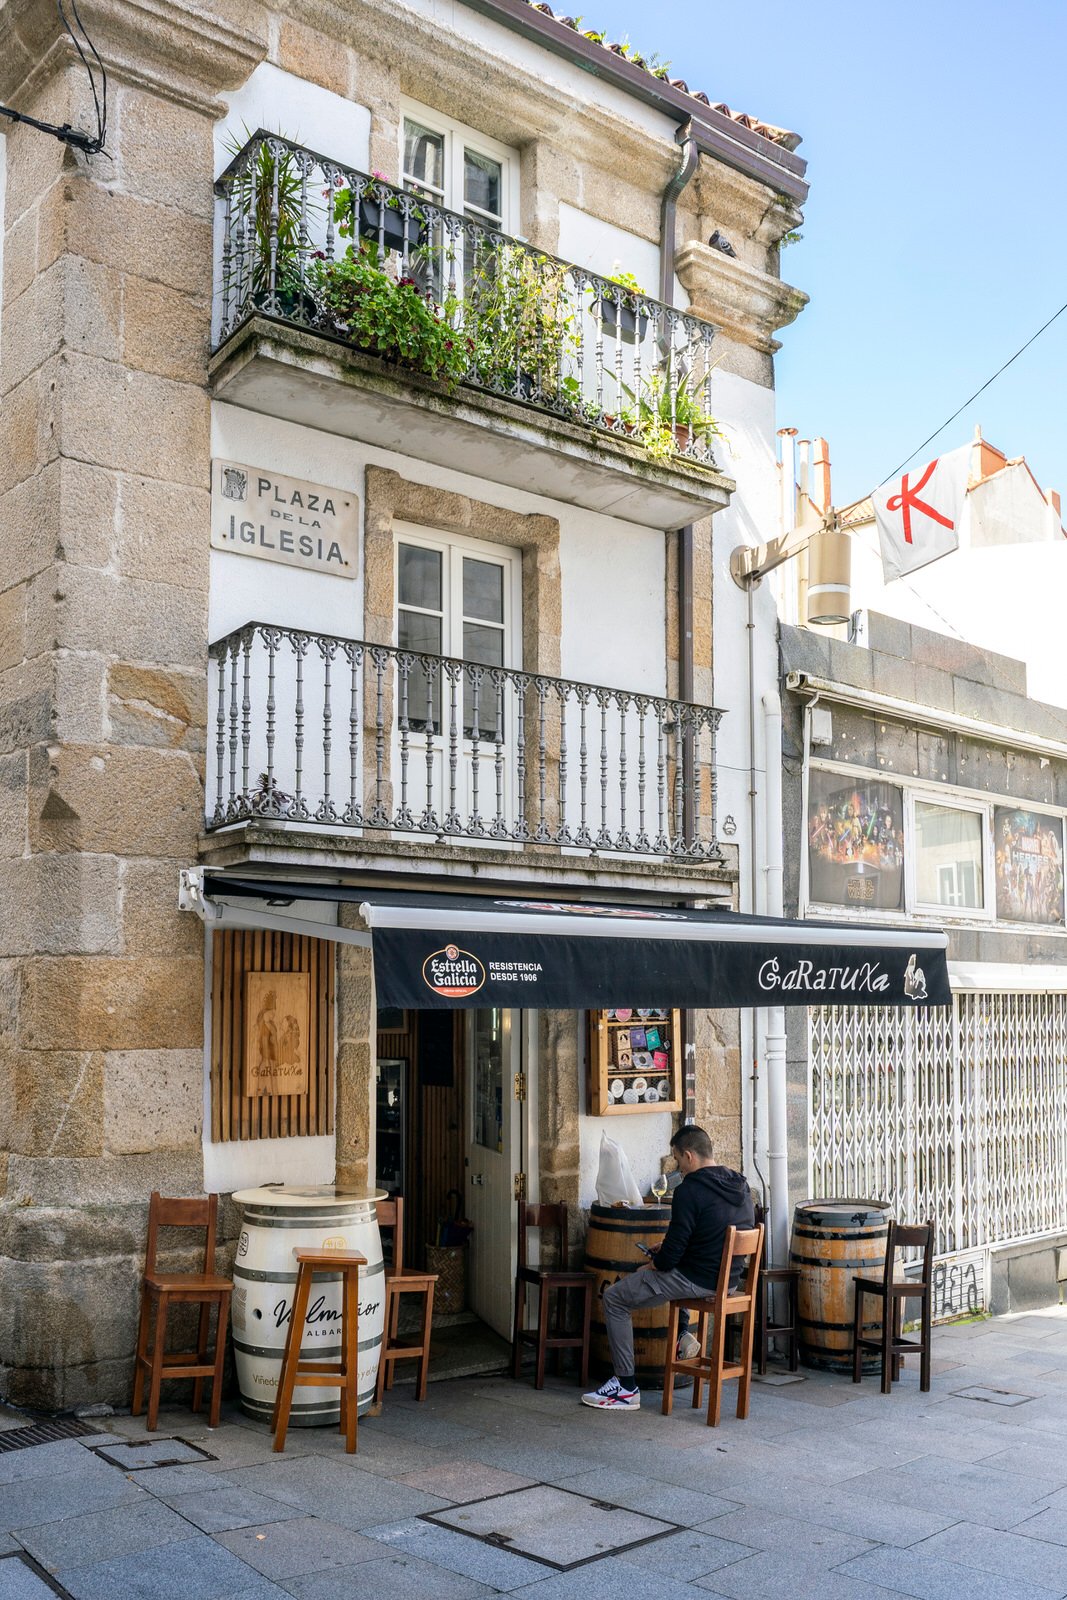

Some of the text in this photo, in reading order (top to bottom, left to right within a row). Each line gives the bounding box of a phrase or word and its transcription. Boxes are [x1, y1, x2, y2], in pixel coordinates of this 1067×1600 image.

[257, 477, 337, 517] PLAZA
[886, 457, 955, 545] K
[270, 509, 322, 529] DE LA
[229, 514, 344, 565] IGLESIA
[430, 959, 477, 973] Estrella
[489, 962, 543, 971] RESISTENCIA
[433, 972, 477, 986] Galicia
[490, 973, 537, 982] DESDE 1906
